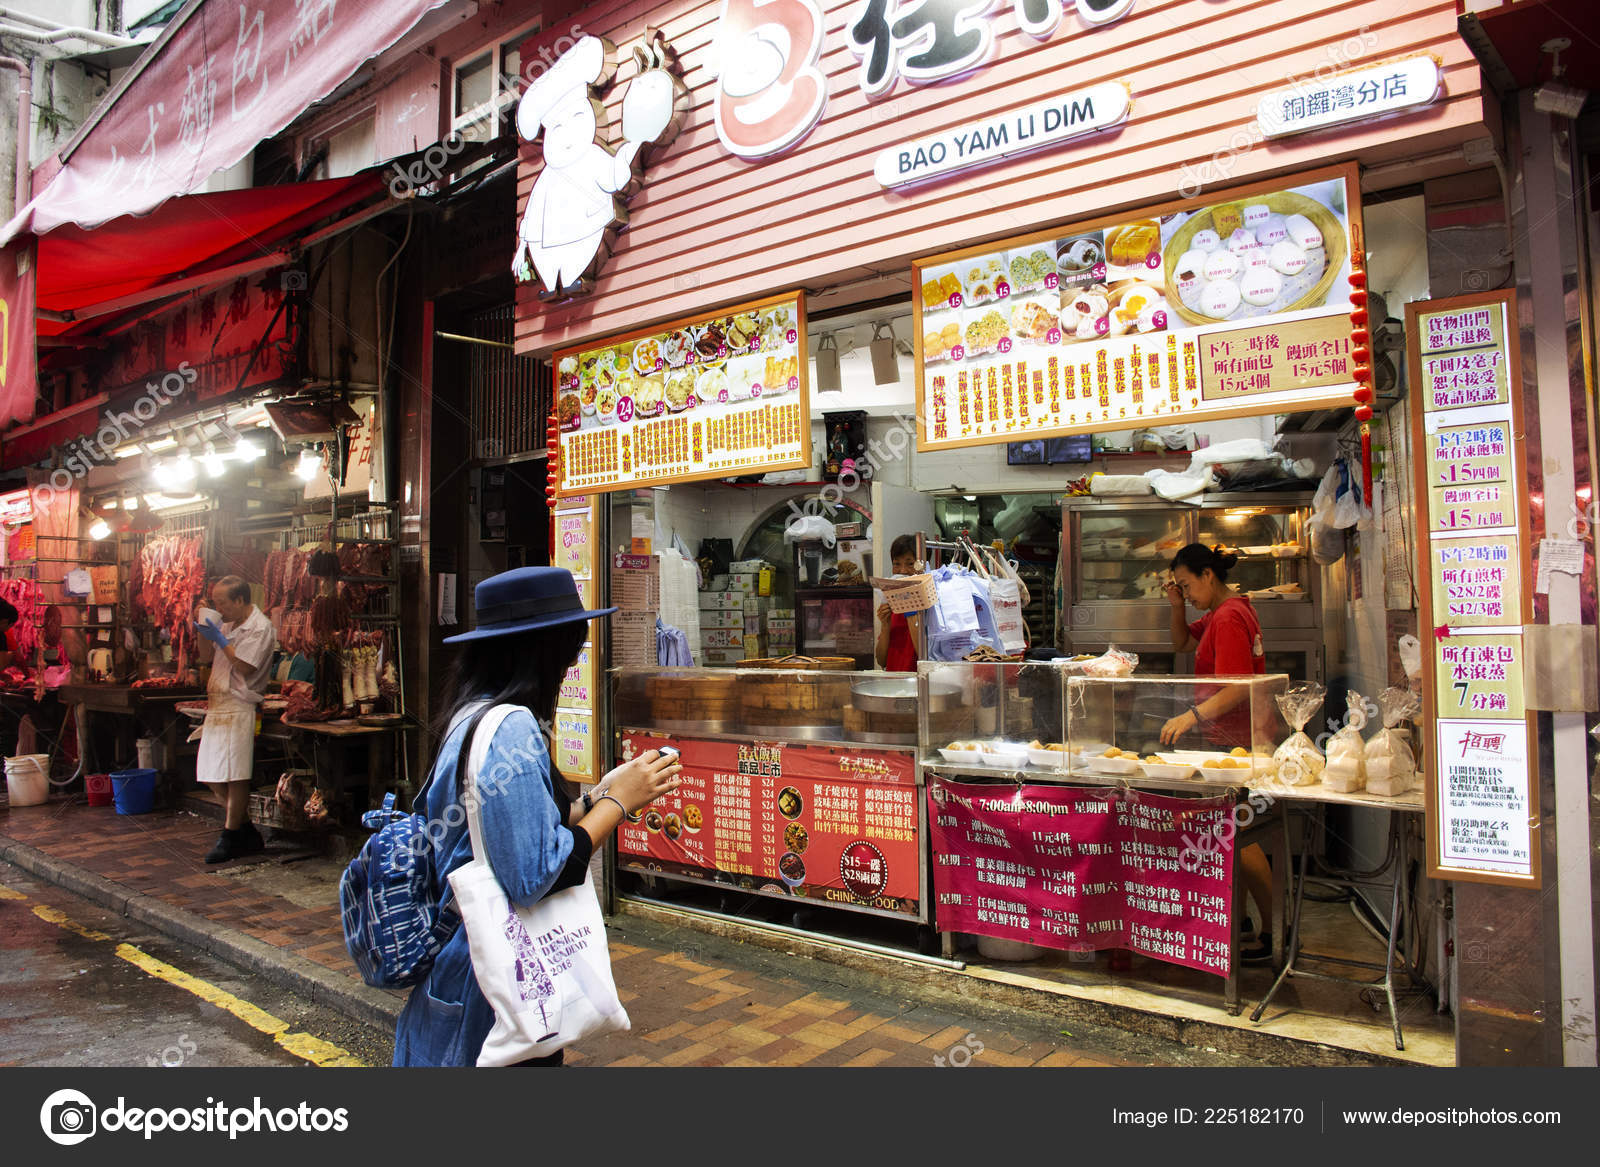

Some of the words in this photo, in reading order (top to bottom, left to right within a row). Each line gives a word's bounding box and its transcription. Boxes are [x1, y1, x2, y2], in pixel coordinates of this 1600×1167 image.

[1282, 73, 1408, 122] 銅鑼灣分店
[898, 141, 947, 174] BAO
[953, 123, 1009, 158] YAM
[1017, 113, 1035, 140] LI
[1043, 96, 1096, 134] DIM
[1047, 277, 1057, 286] 15
[999, 287, 1009, 295] 15
[952, 297, 961, 305] 15
[1428, 310, 1490, 332] 貨物出門
[1001, 341, 1010, 350] 15
[1049, 333, 1059, 342] 15
[1208, 333, 1281, 358] 下午二時後
[1428, 327, 1492, 349] 恕不退換
[953, 350, 962, 358] 15
[1286, 337, 1349, 361] 饅頭全日
[1213, 354, 1274, 375] 所有面包
[1292, 358, 1347, 377] 15元5個
[1219, 372, 1271, 392] 15元4個
[1432, 369, 1496, 390] 恕不接受
[1191, 398, 1198, 408] 9
[1433, 386, 1497, 407] 敬請原諒
[619, 400, 632, 416] 24
[933, 375, 947, 439] 傳統包點
[1436, 427, 1503, 447] 下午2時後
[1440, 463, 1500, 482] $15四個
[1436, 545, 1507, 563] 下午2時前
[1442, 567, 1506, 584] 所有煎炸
[1448, 585, 1502, 600] $28/2碟
[1448, 602, 1502, 617] $42/3碟
[1442, 646, 1514, 663] 所有凍包
[1451, 663, 1506, 681] 水滾蒸
[1453, 682, 1469, 707] 7
[1471, 693, 1507, 710] 分鐘
[1458, 730, 1501, 758] 招聘
[738, 759, 782, 778] 新品上市
[937, 815, 967, 827] 星期一
[1074, 801, 1109, 814] 星期四
[1181, 809, 1226, 823] 11元4件
[814, 820, 859, 836] 山竹牛肉球
[1032, 831, 1072, 845] 11元4件
[1034, 844, 1073, 857] 11元4件
[1077, 842, 1114, 856] 星期五
[844, 855, 881, 871] $15一碟
[938, 854, 971, 866] 星期二
[1040, 867, 1077, 884] 11元4件
[1121, 855, 1180, 873] 山竹牛肉球
[844, 869, 881, 885] $28兩碟
[1042, 880, 1078, 898] 11元4件
[1081, 881, 1119, 896] 星期六
[1187, 890, 1226, 911] 11元4件
[939, 893, 973, 906] 星期三
[1191, 906, 1229, 928] 11元4件
[1040, 920, 1080, 938] 11元3件
[1086, 919, 1124, 934] 星期日
[1192, 934, 1229, 957] 11元4件
[540, 925, 592, 957] DESIGNER
[1130, 934, 1186, 959] 生煎菜肉包
[1192, 950, 1229, 973] 11元4件
[550, 958, 573, 977] 2018
